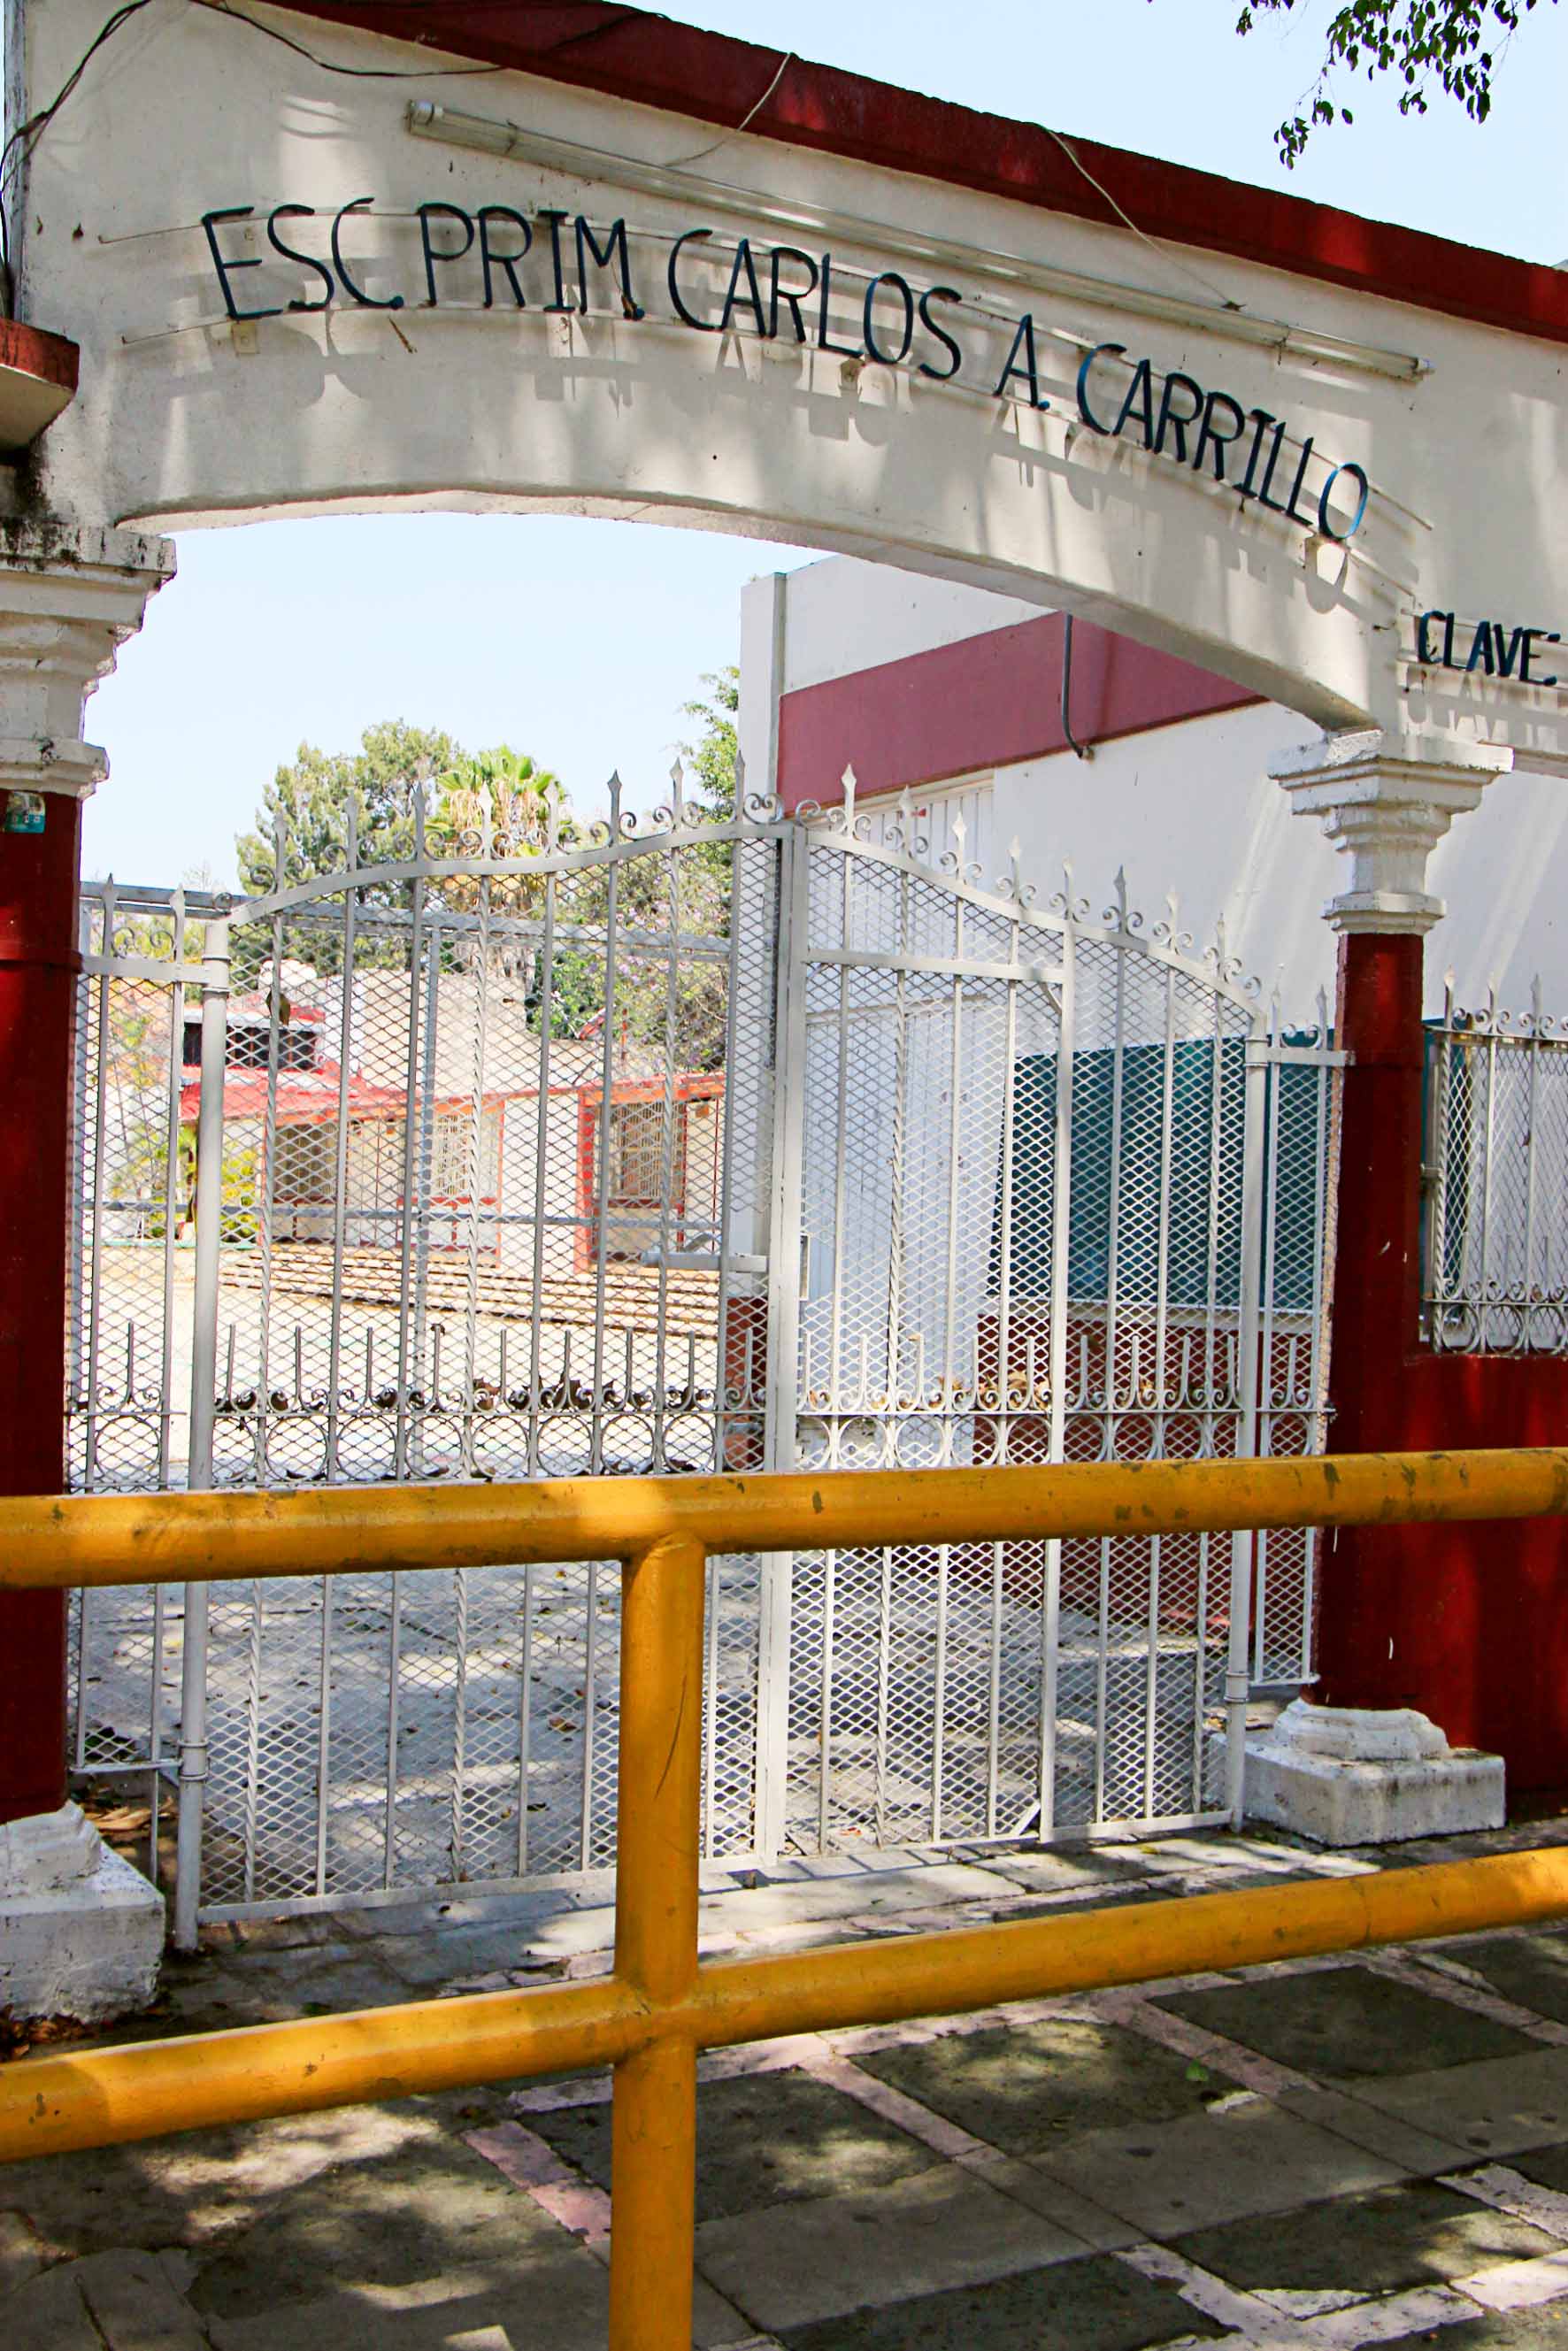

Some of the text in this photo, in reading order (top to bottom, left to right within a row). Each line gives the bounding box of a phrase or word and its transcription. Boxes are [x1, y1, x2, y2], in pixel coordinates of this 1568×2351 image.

[666, 227, 964, 380] CARLOS
[993, 313, 1050, 411] A.
[1076, 343, 1370, 541] CARRILLO
